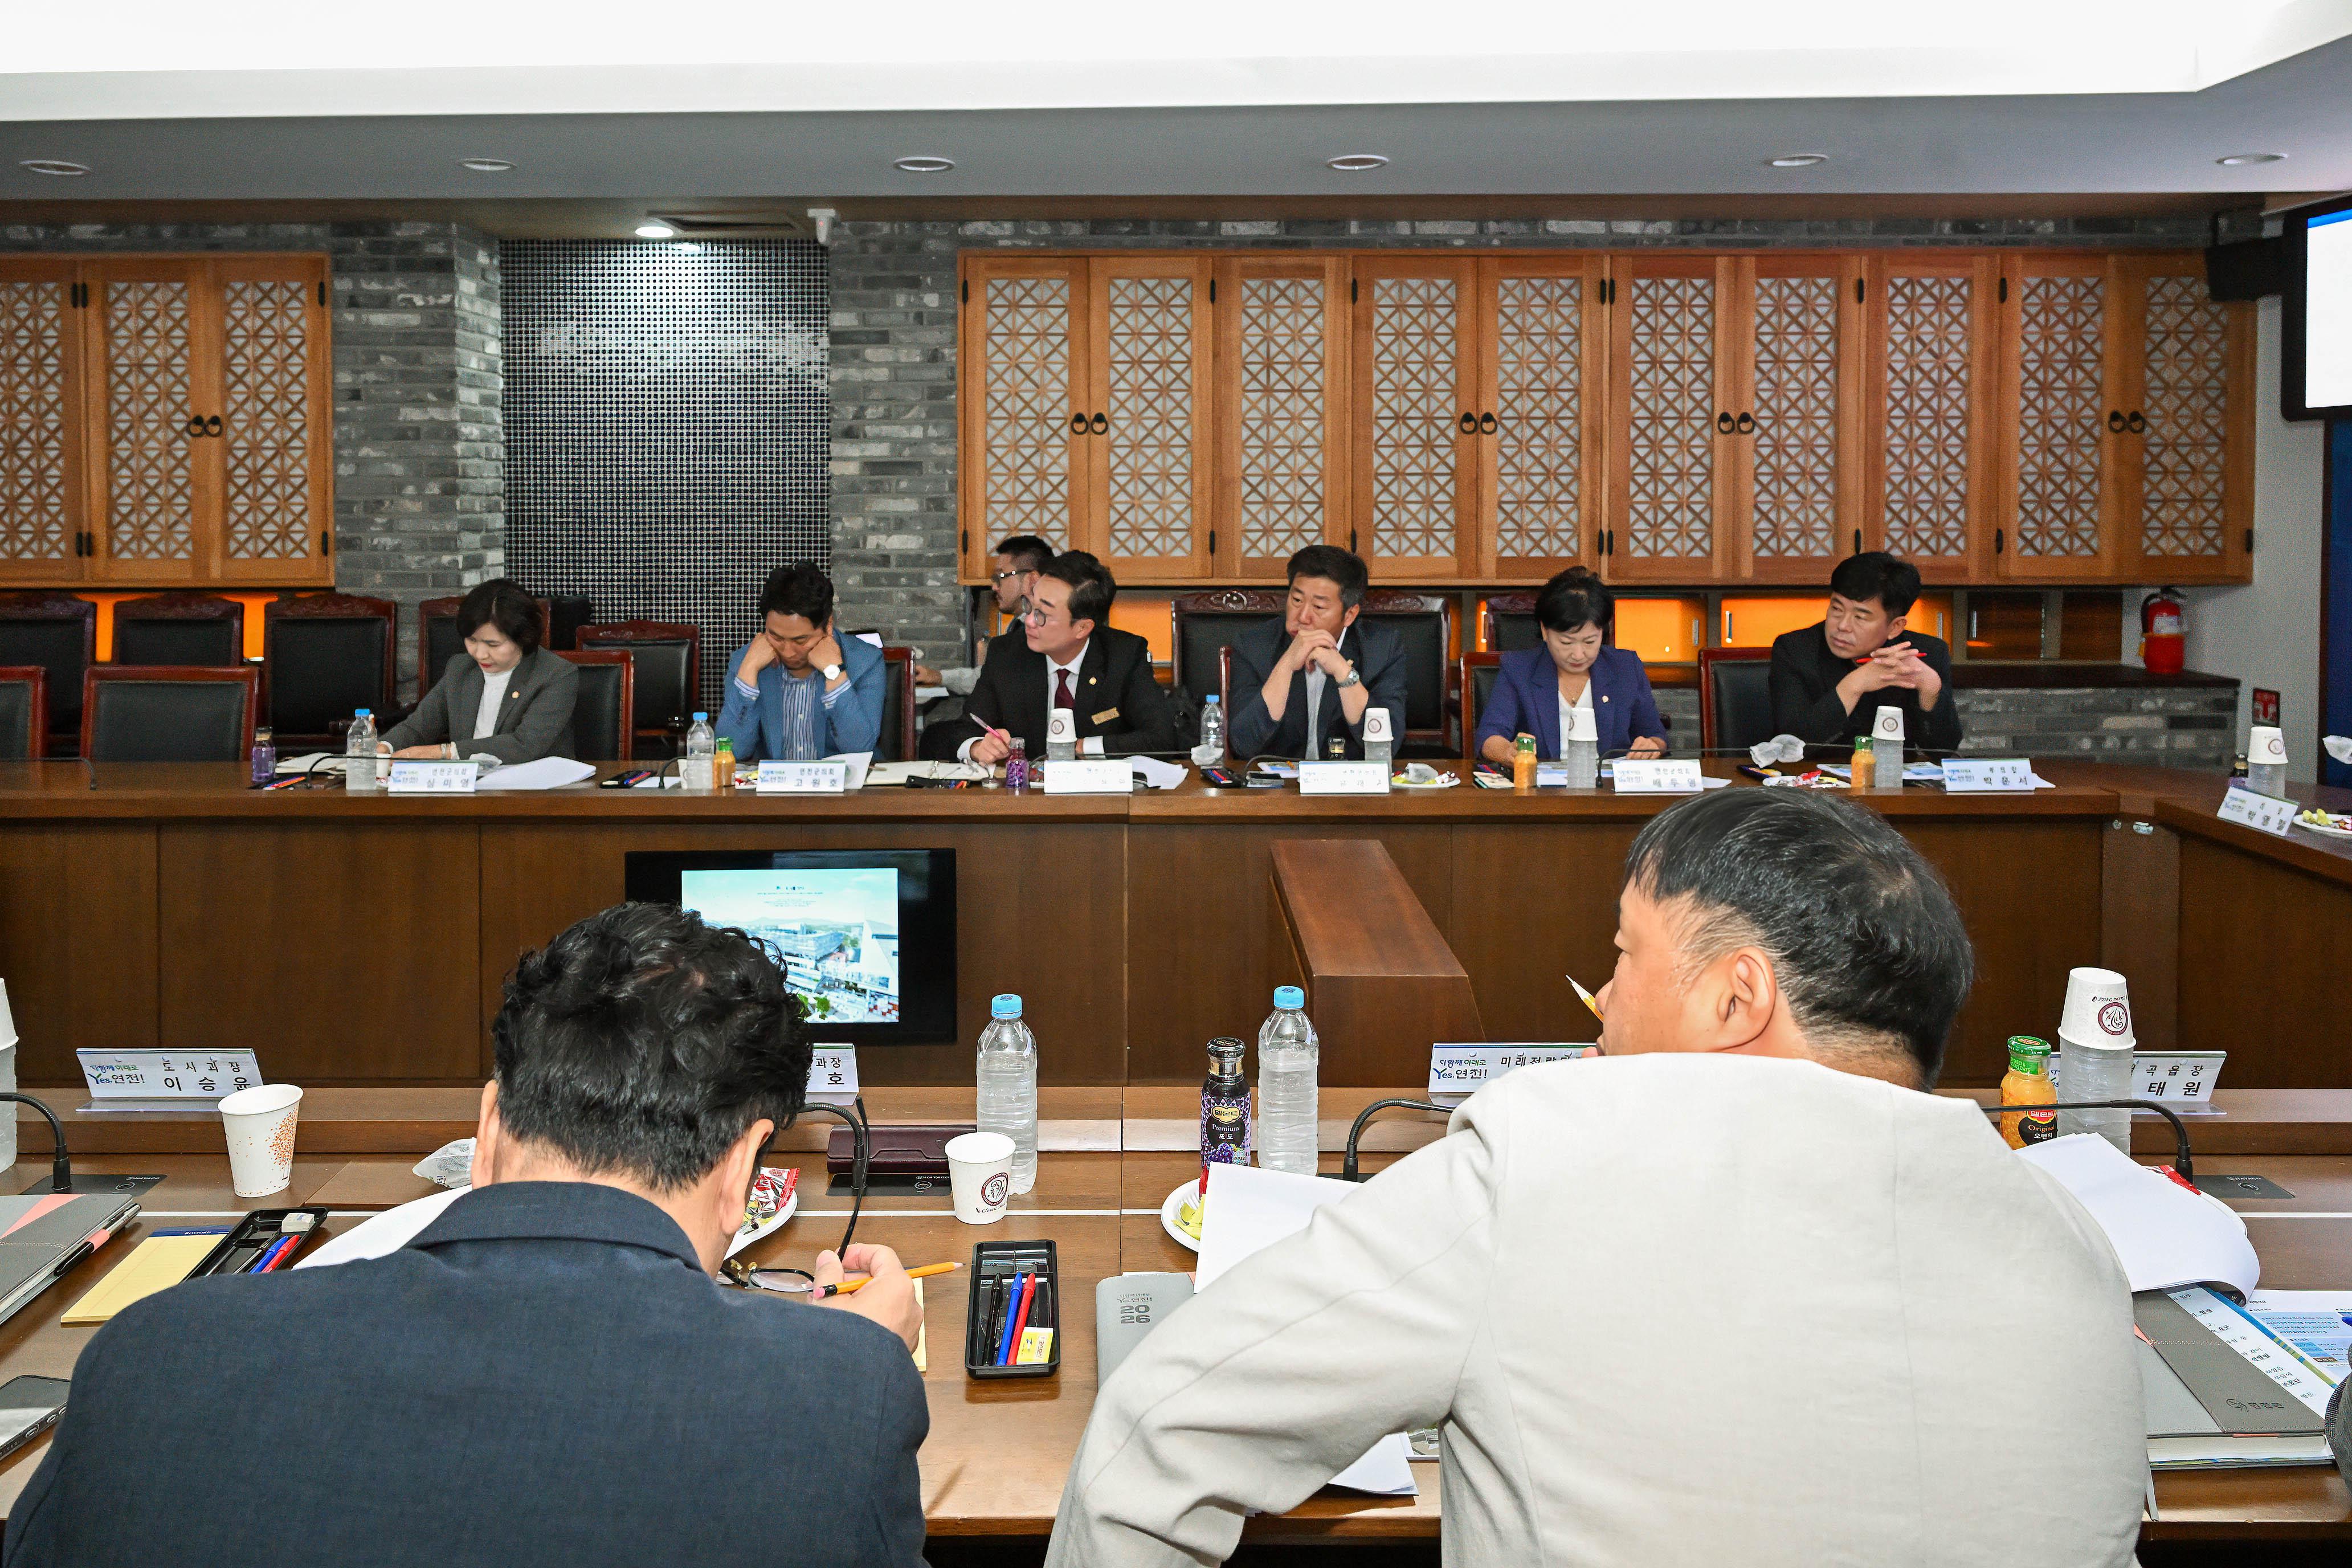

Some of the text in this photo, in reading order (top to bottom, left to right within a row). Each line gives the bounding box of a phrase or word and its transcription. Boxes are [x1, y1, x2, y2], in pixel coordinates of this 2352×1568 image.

[827, 1072, 845, 1085] 호
[1455, 1068, 1488, 1079] 연천!
[2147, 1081, 2201, 1096] 태원
[1212, 1124, 1240, 1132] Premium
[1120, 1304, 1150, 1314] 20
[1121, 1314, 1150, 1324] 26
